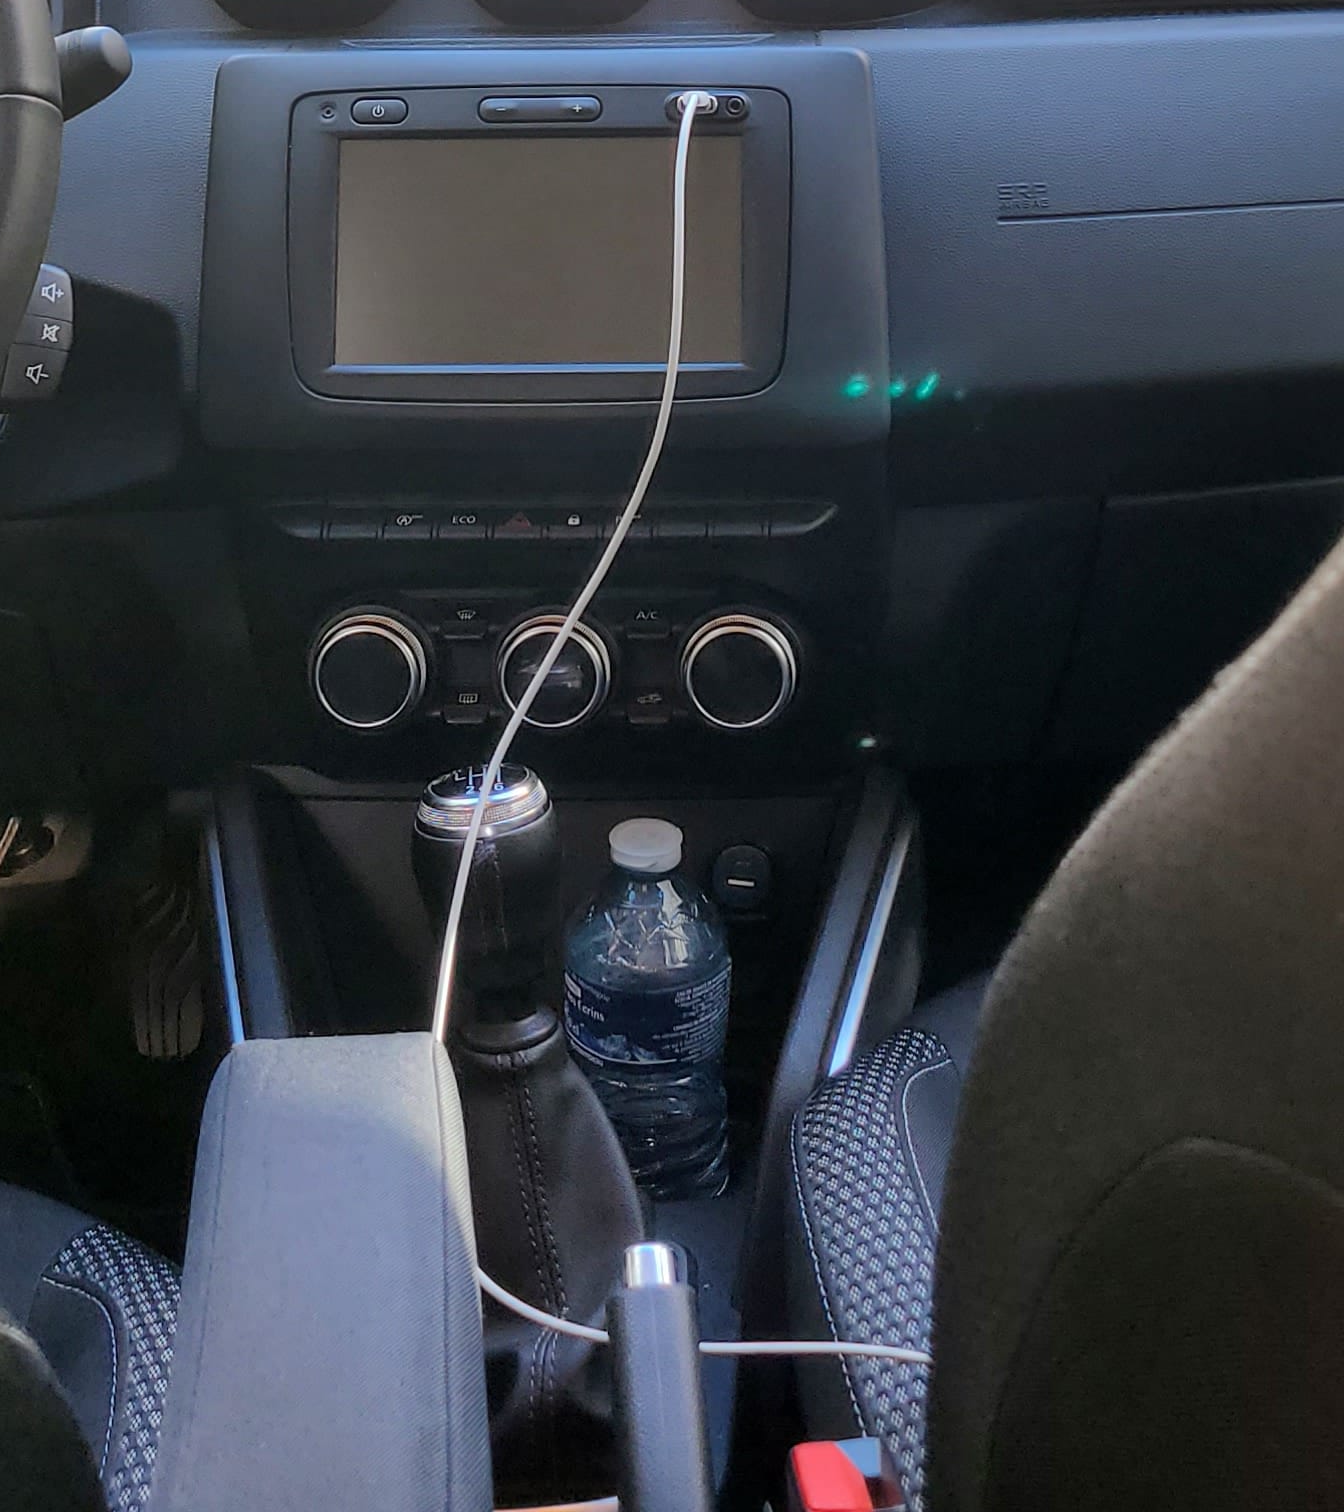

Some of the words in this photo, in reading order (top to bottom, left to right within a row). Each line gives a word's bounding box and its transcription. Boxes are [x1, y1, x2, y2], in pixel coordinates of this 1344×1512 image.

[452, 515, 476, 524] ECO
[636, 610, 658, 620] A/C
[465, 785, 475, 795] 2
[494, 782, 505, 791] 6
